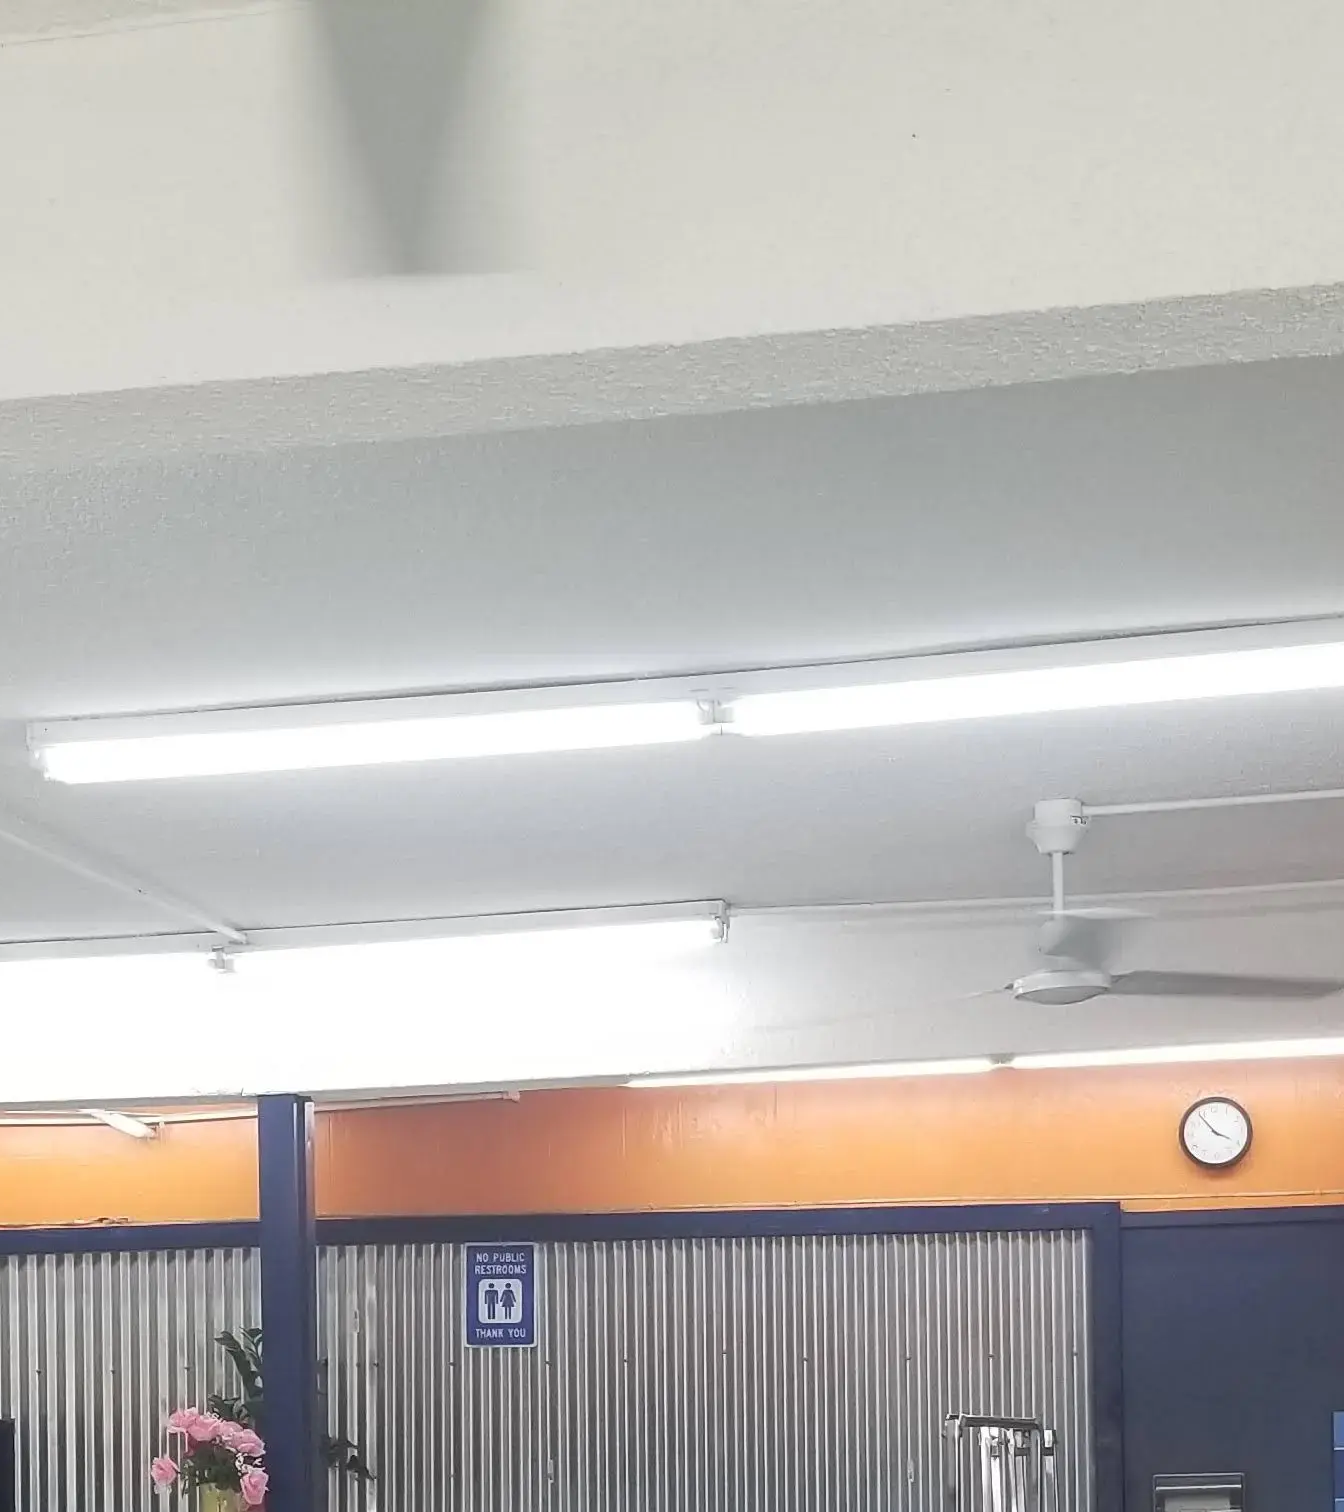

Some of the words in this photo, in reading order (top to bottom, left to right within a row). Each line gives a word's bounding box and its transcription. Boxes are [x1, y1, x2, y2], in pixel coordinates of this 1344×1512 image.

[476, 1253, 489, 1263] NO
[493, 1253, 525, 1263] PUBLIC
[475, 1265, 527, 1275] RESTROOMS
[476, 1328, 504, 1338] THANK
[508, 1328, 526, 1338] YOU
